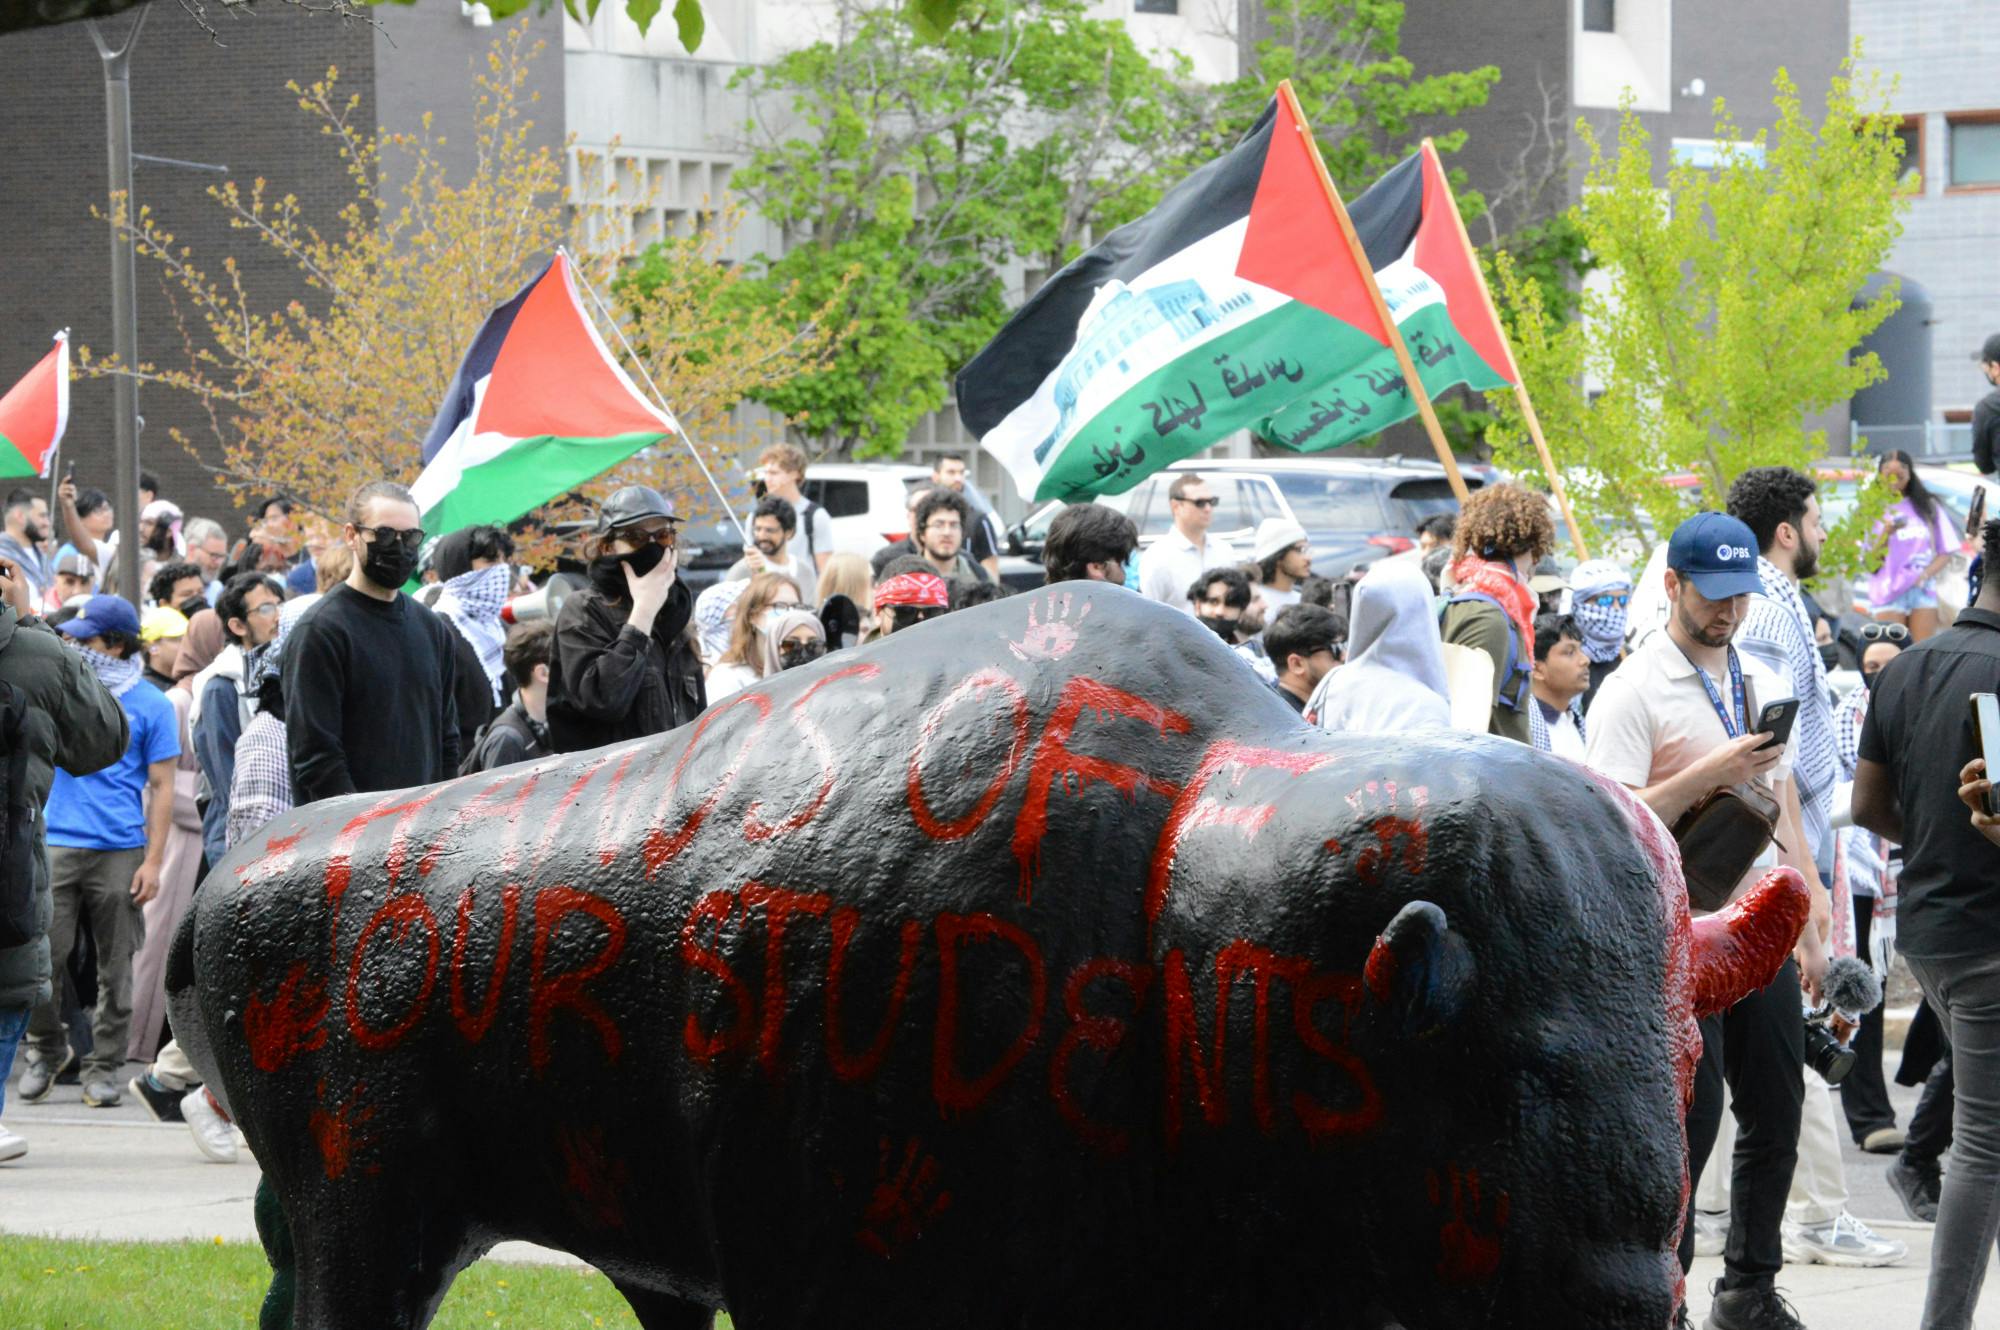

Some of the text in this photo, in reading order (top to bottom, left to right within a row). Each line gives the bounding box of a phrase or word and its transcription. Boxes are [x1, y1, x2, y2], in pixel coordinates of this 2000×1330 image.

[908, 668, 1338, 935] OFF
[345, 880, 1384, 1150] OUR STUDENTS
